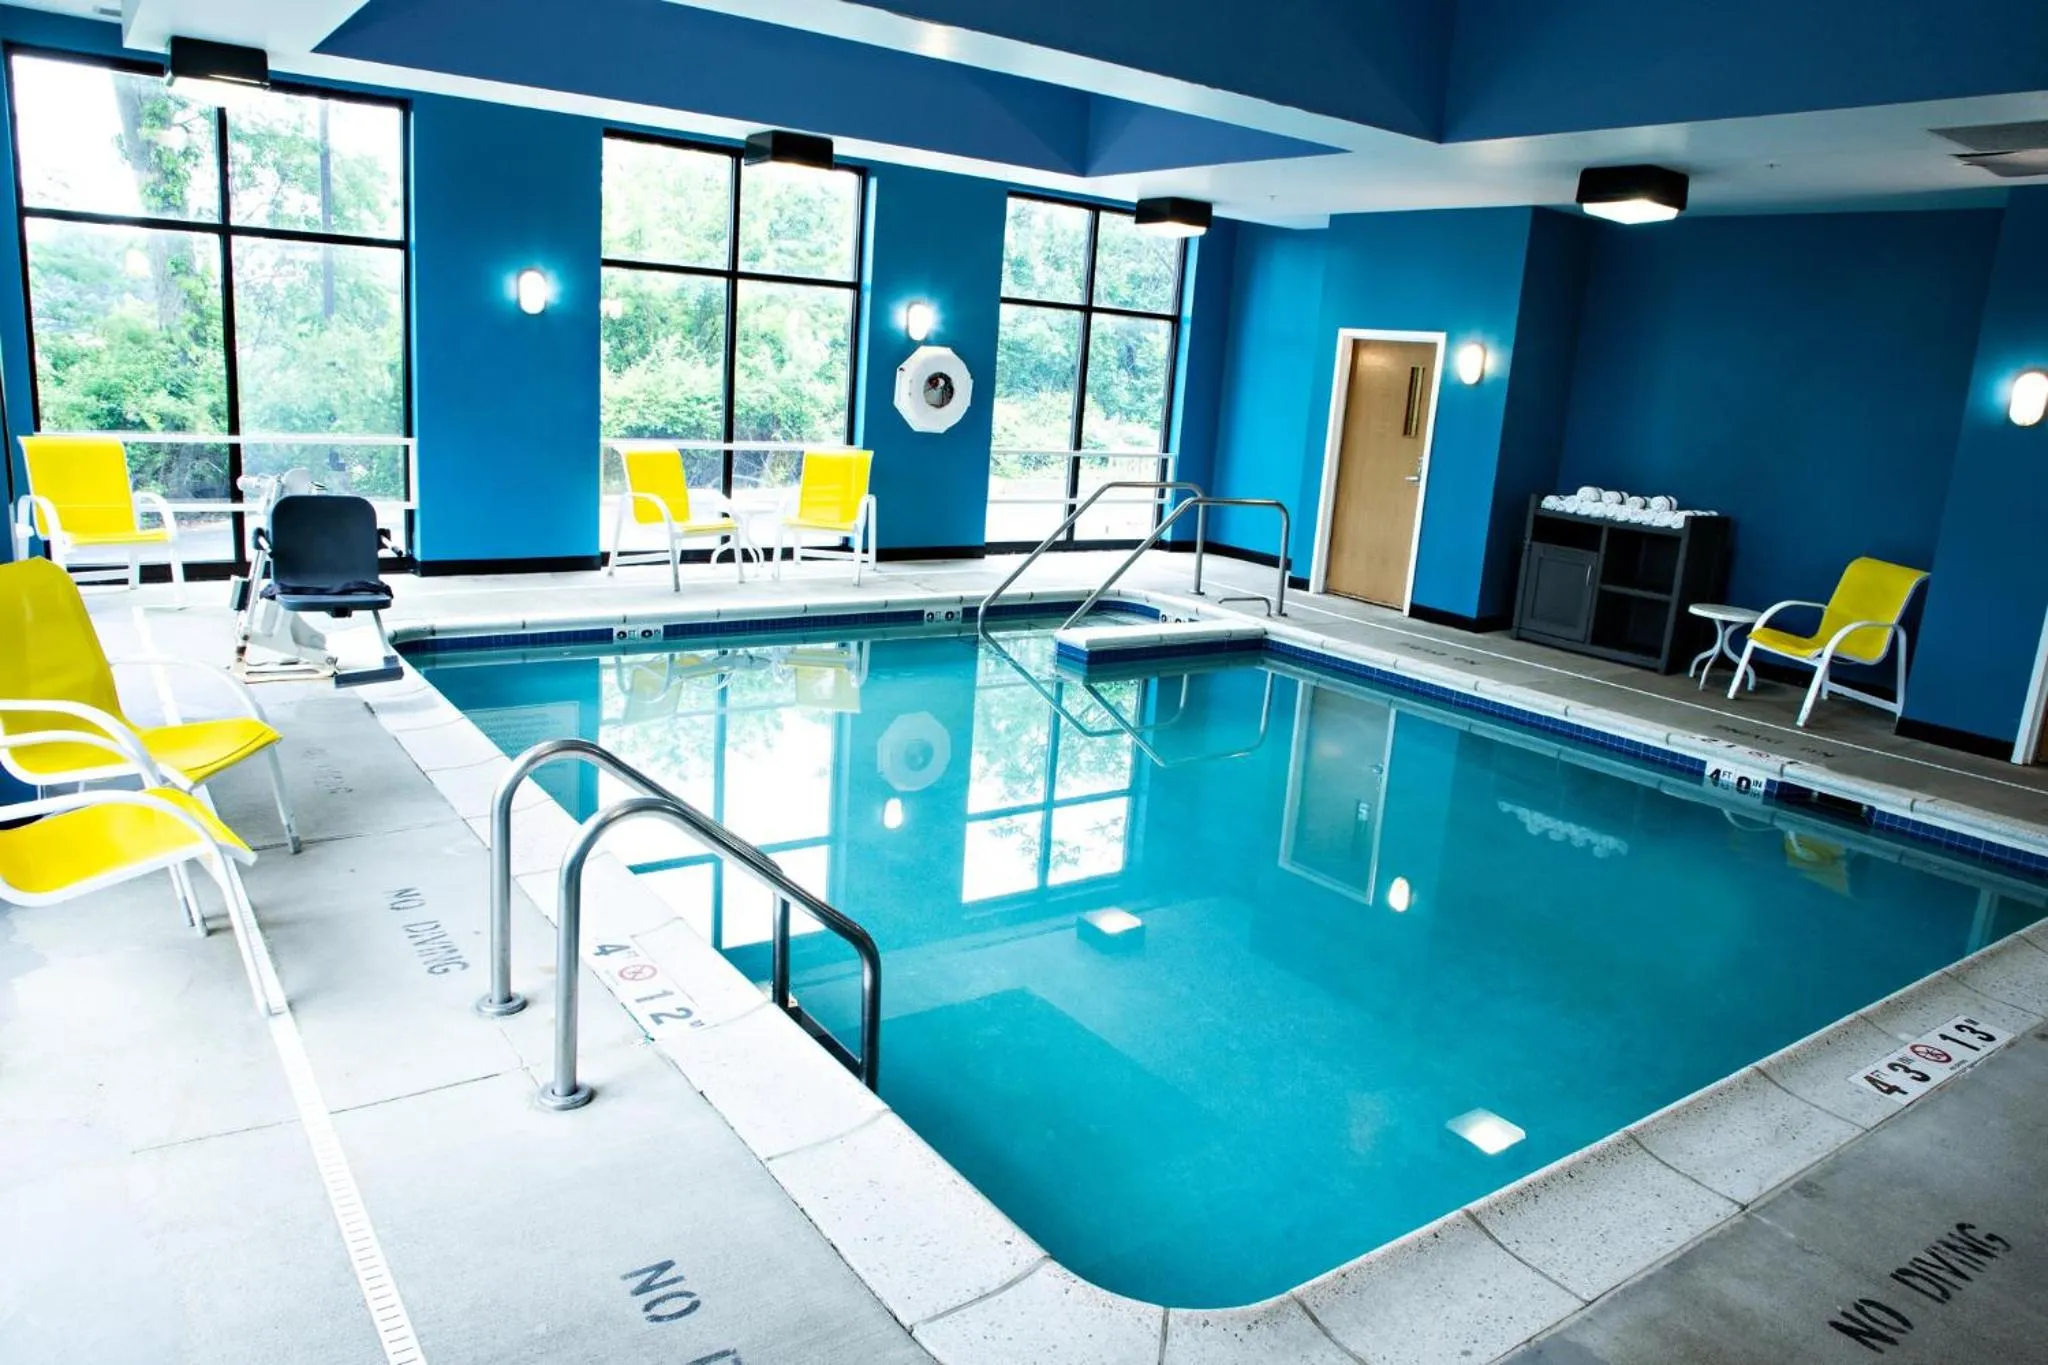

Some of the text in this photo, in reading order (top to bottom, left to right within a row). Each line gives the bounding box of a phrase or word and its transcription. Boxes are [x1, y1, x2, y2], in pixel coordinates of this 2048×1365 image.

[1722, 770, 1732, 779] FT
[389, 887, 469, 975] NO DIVING
[593, 944, 630, 956] 4
[1864, 1075, 1909, 1095] 4
[1887, 1062, 1931, 1082] 3
[620, 1259, 701, 1323] NO
[1828, 1222, 2012, 1354] NO DIVING
